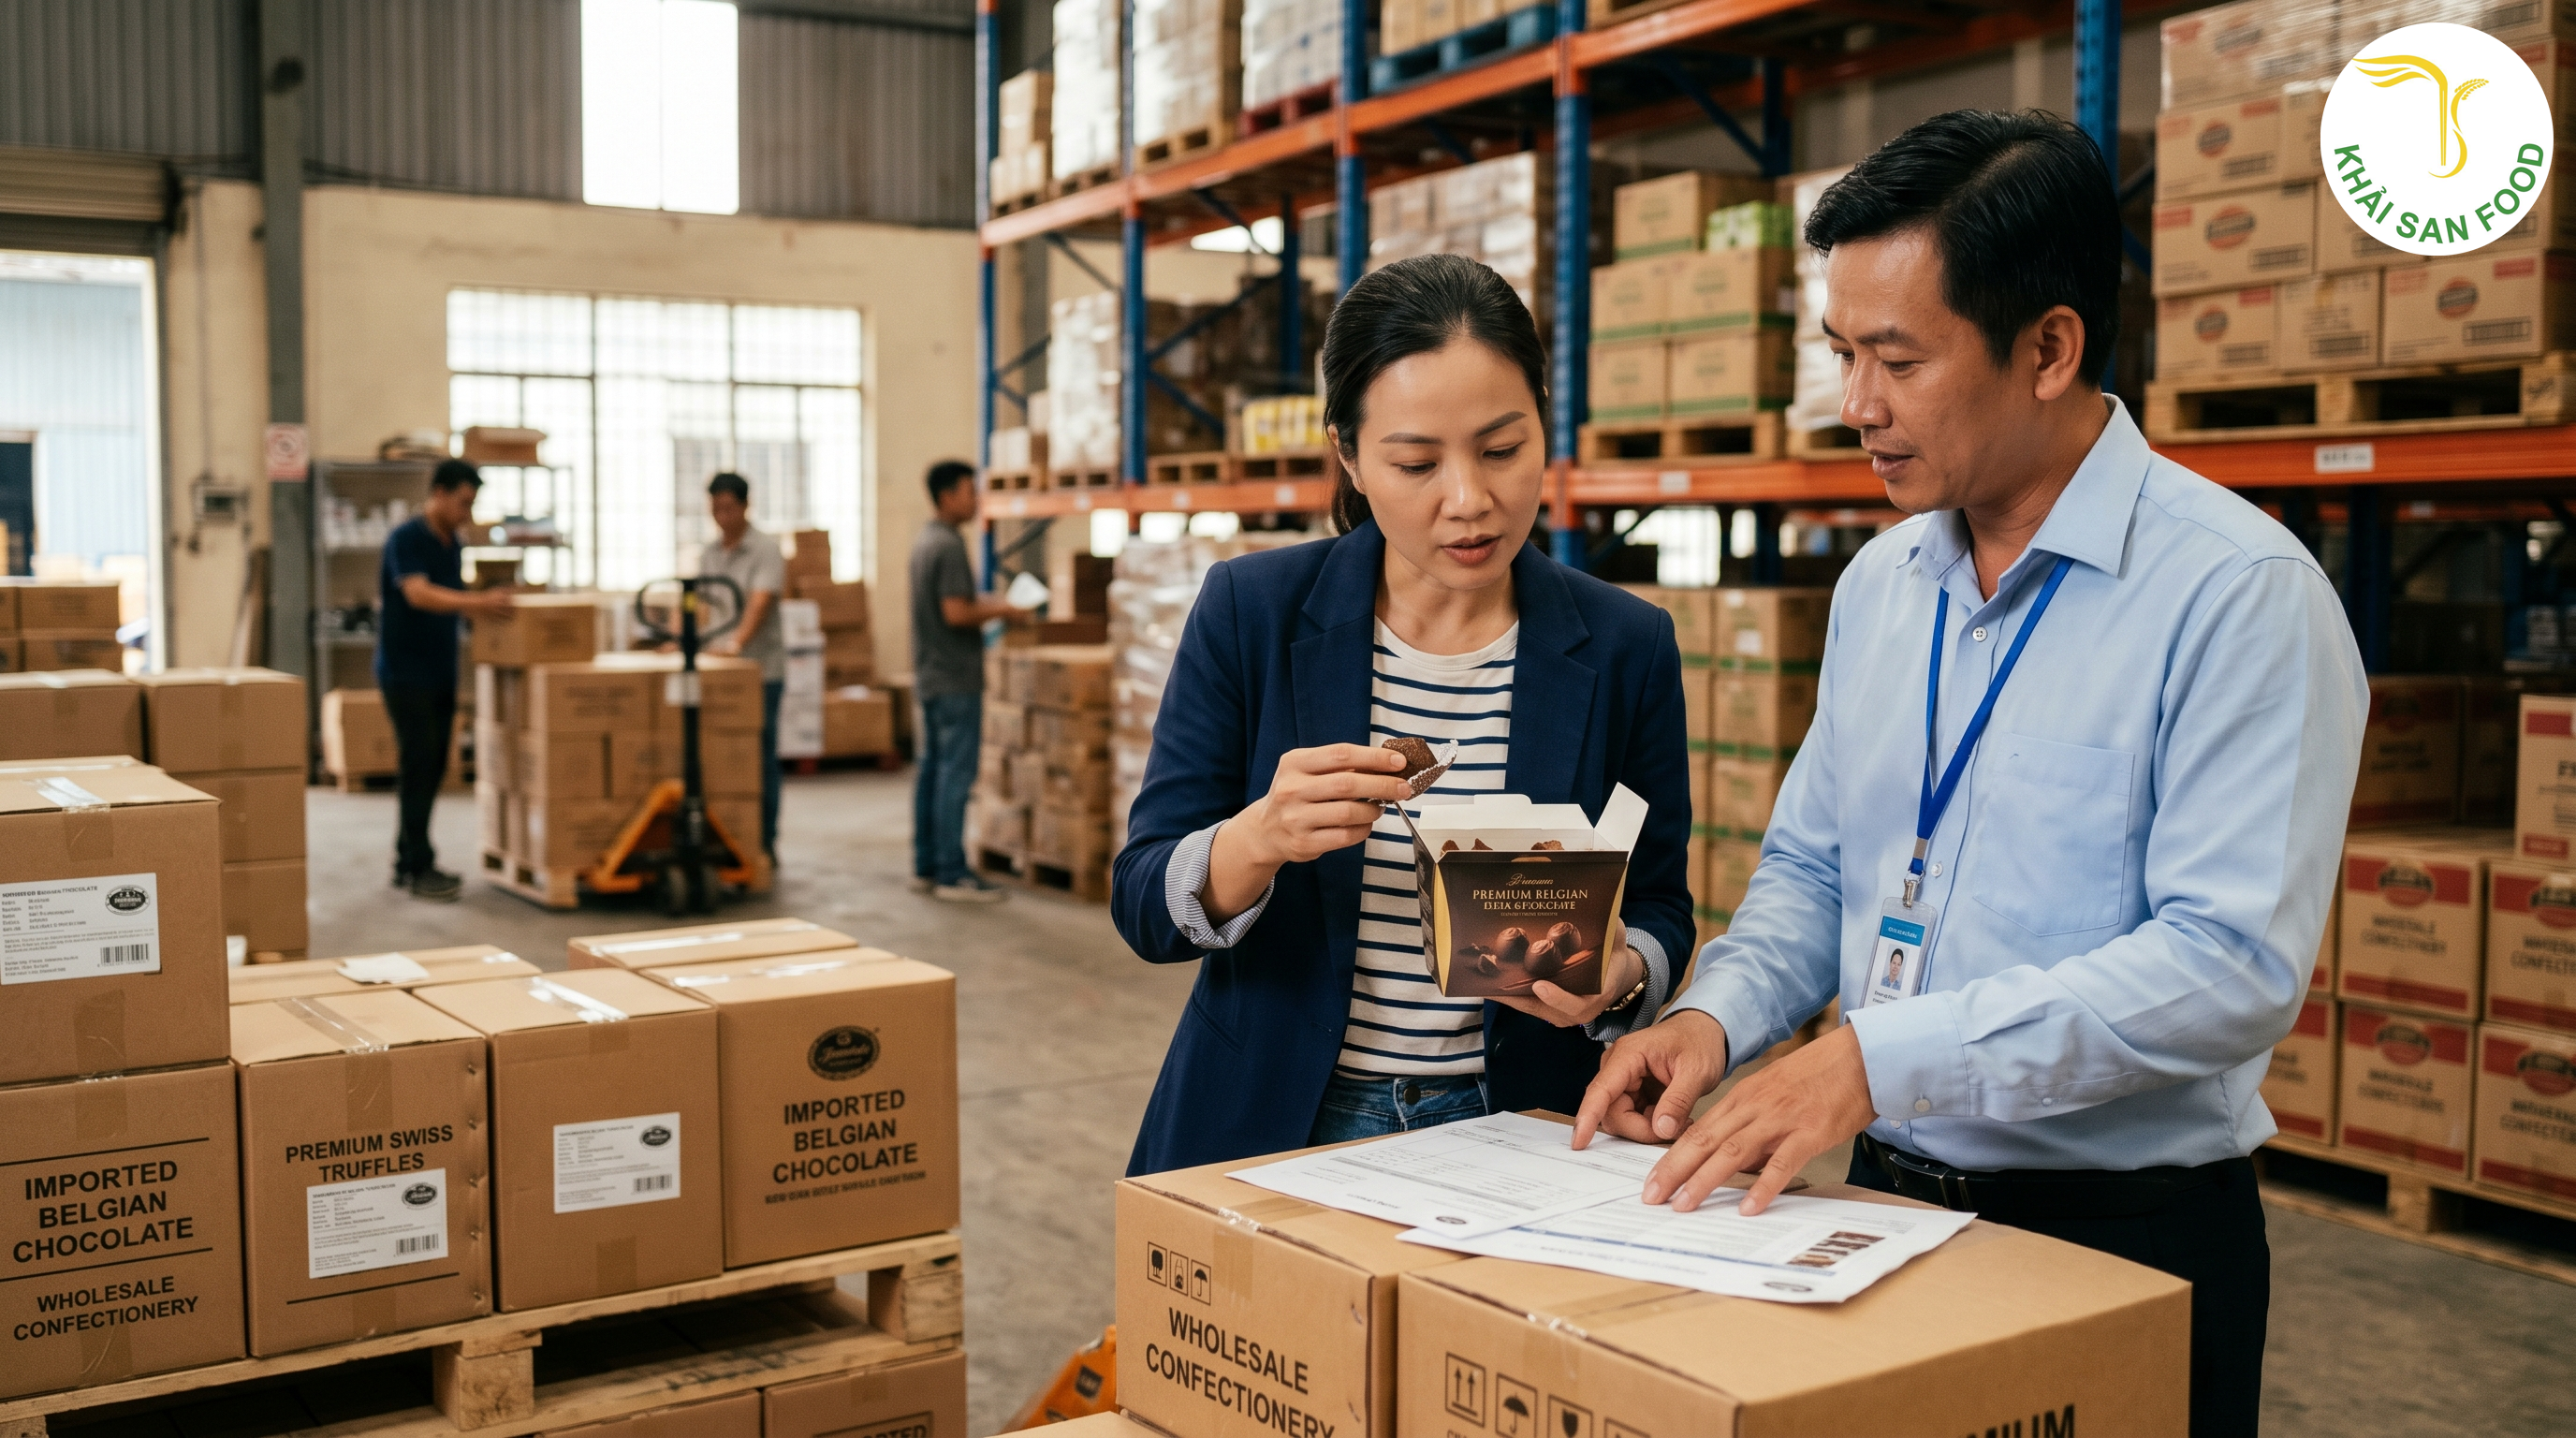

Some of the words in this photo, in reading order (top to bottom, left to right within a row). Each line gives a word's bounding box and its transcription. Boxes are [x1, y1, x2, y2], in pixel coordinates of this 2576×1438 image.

[1472, 889, 1532, 900] PREMIUM
[783, 1089, 906, 1125] IMPORTED
[285, 1134, 383, 1164] PREMIUM
[389, 1124, 454, 1150] SWISS
[794, 1118, 897, 1152] BELGIAN
[25, 1160, 178, 1200] IMPORTED
[318, 1152, 425, 1182] TRUFFLES
[772, 1142, 918, 1184] CHOCOLATE
[39, 1191, 167, 1229] BELGIAN
[13, 1217, 194, 1263] CHOCOLATE
[37, 1276, 175, 1313] WHOLESALE
[13, 1296, 198, 1341] CONFECTIONERY
[1169, 1307, 1309, 1396] WHOLESALE
[1146, 1343, 1335, 1438] CONFECTIONERY
